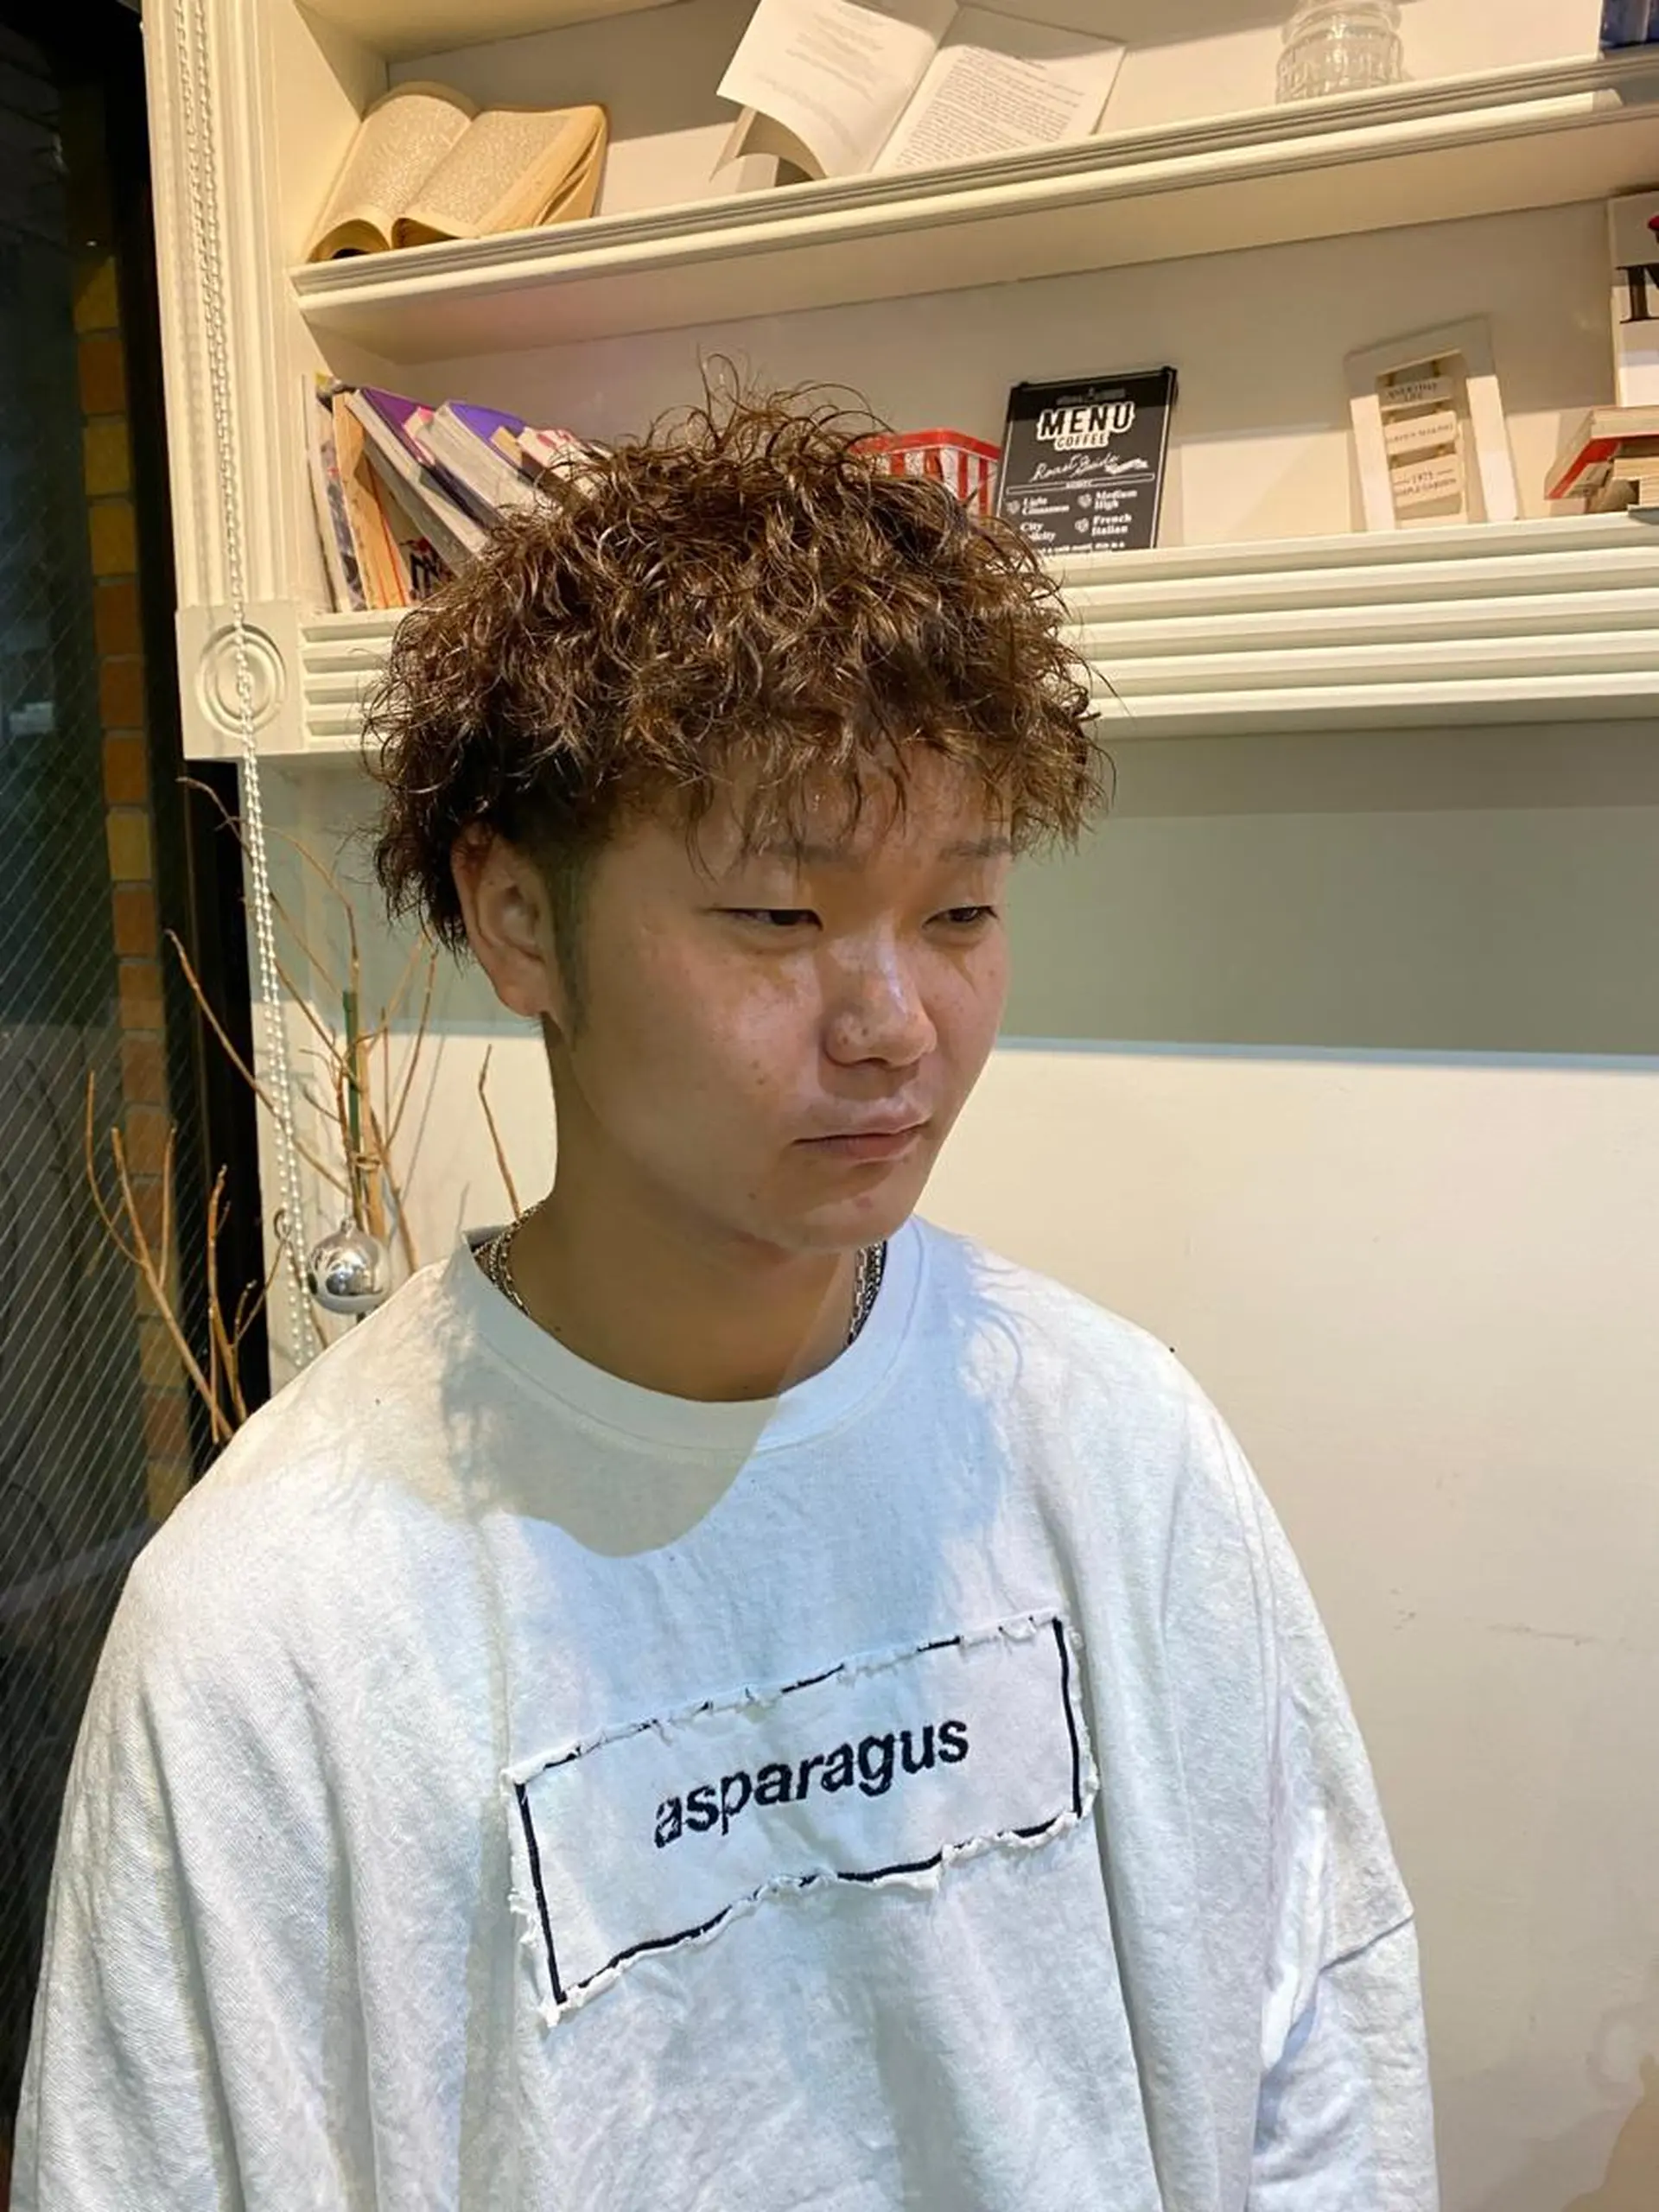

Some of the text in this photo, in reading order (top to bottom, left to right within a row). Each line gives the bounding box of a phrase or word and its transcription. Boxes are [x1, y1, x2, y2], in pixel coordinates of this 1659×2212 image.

[1039, 403, 1132, 437] MENU
[1056, 433, 1105, 448] COFFEE
[1092, 513, 1133, 525] French
[654, 1720, 969, 1849] asparagus
